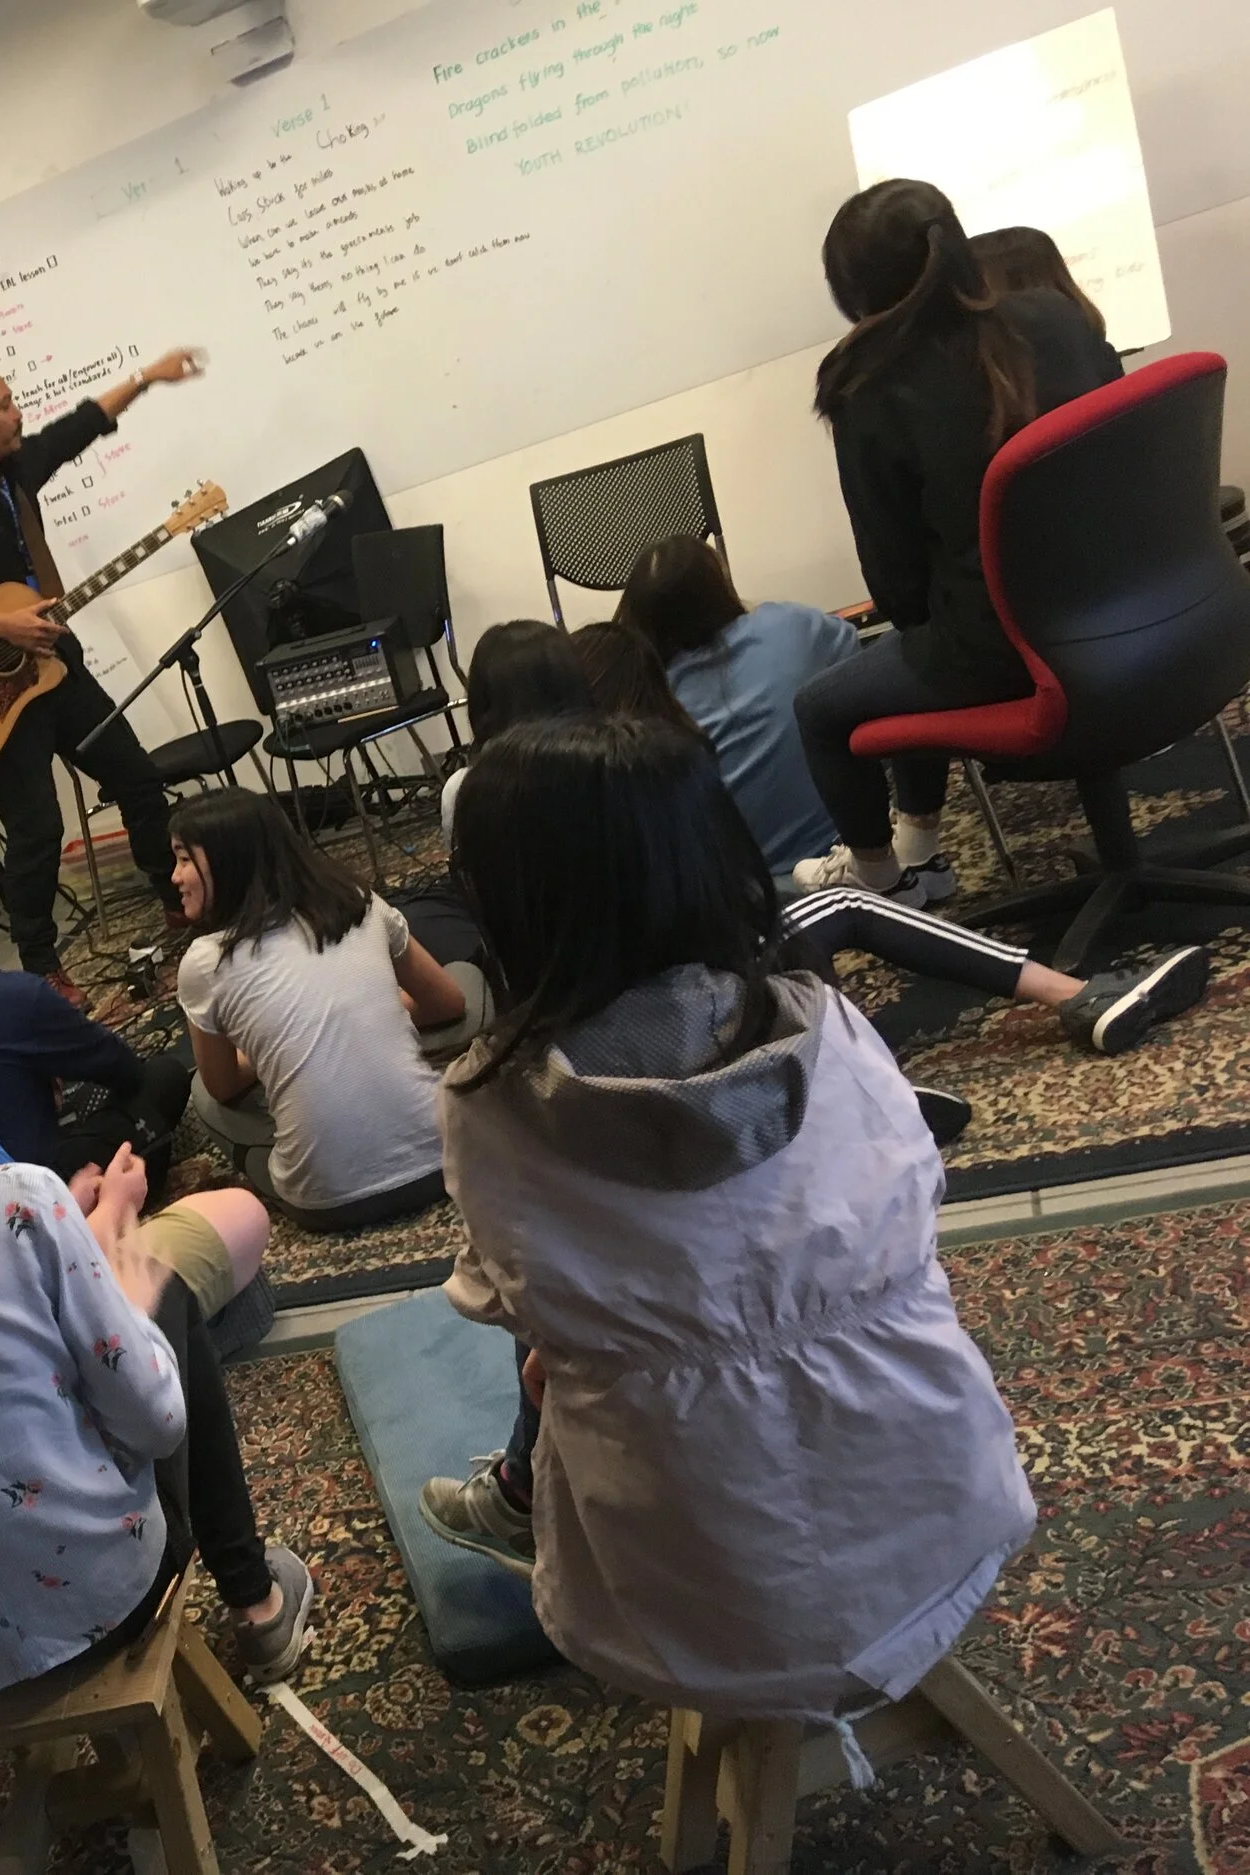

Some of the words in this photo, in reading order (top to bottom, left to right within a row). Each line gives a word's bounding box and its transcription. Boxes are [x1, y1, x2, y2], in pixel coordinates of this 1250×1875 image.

[433, 63, 463, 84] Fire
[475, 29, 540, 65] crackers
[551, 19, 566, 32] in
[576, 1, 600, 19] the
[448, 85, 508, 119] Dragons
[519, 62, 565, 91] flying
[572, 33, 625, 58] through
[632, 22, 653, 38] the
[659, 3, 698, 29] night
[574, 89, 610, 115] from
[717, 45, 738, 60] so
[747, 26, 780, 49] now
[271, 108, 313, 138] Verse
[321, 93, 330, 111] 1
[513, 149, 563, 176] YOUTH
[19, 267, 46, 283] lesson
